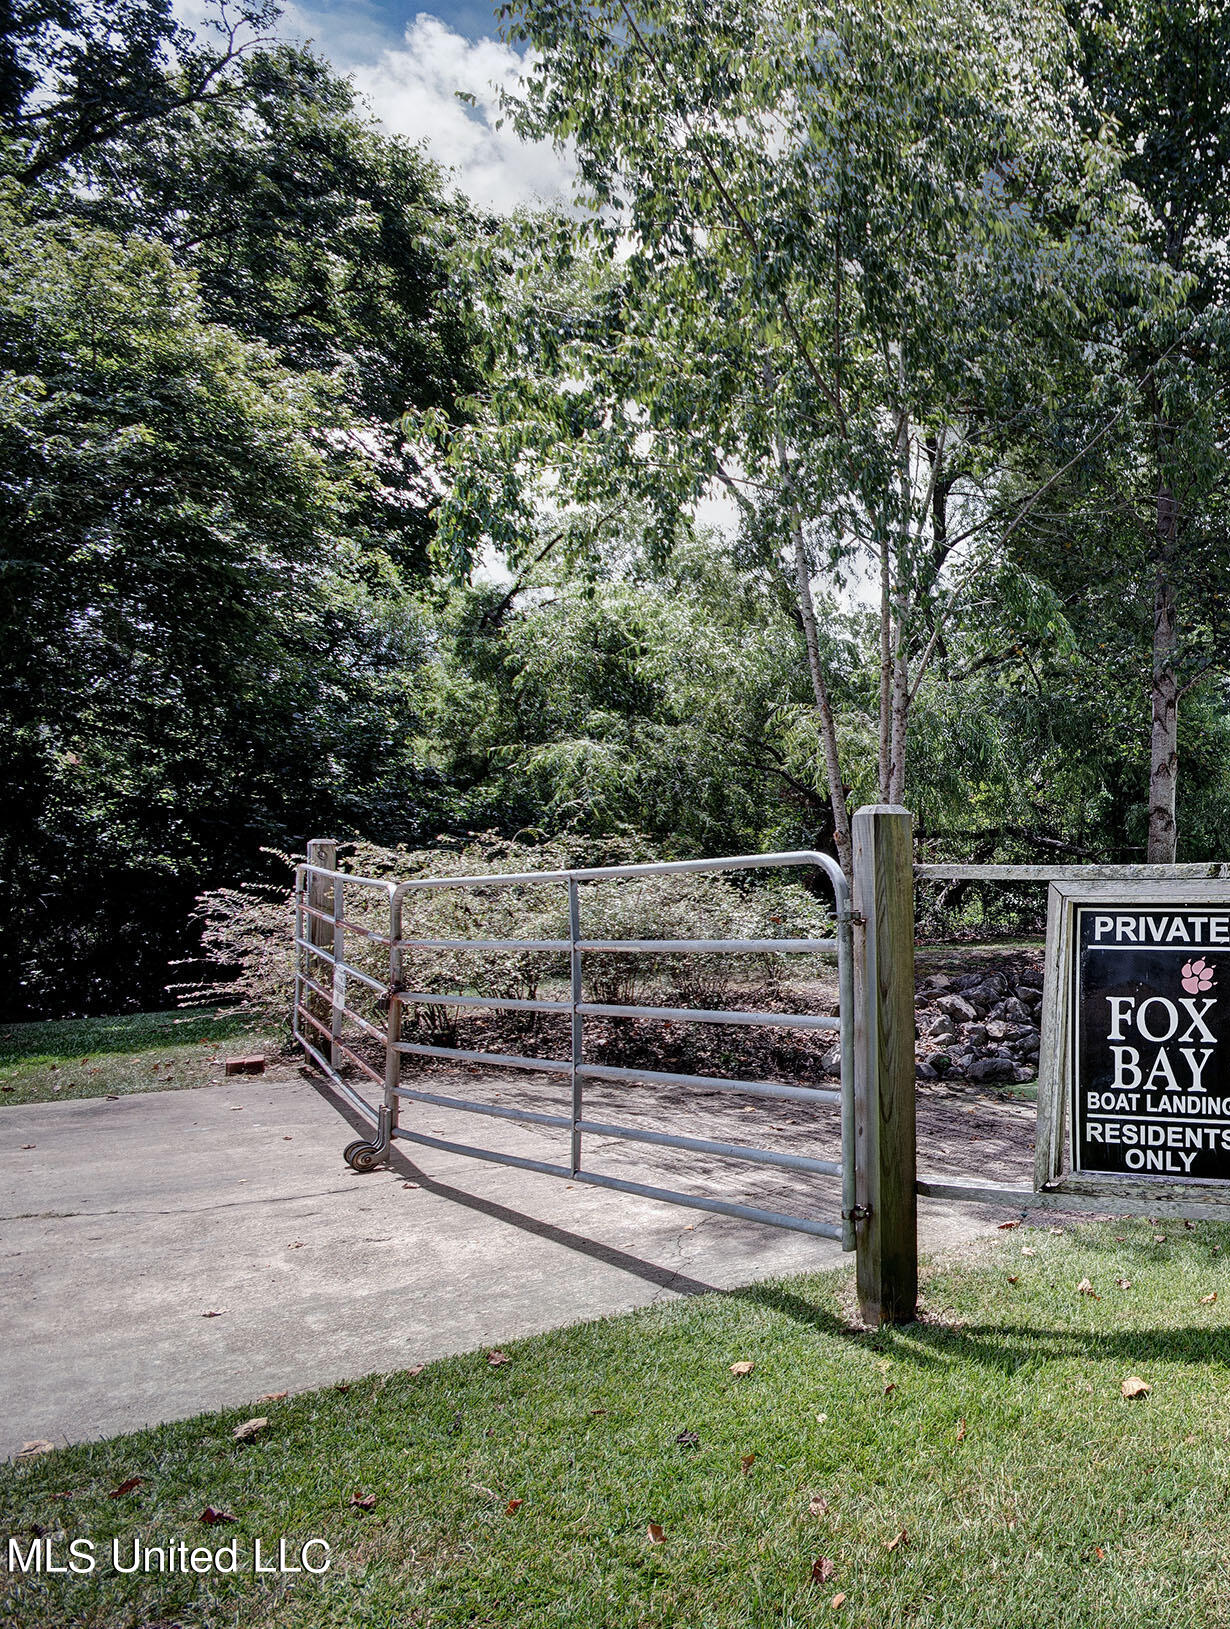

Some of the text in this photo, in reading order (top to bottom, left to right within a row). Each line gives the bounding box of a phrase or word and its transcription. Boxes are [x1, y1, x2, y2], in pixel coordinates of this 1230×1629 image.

[1094, 916, 1230, 943] PRIVATE
[1105, 996, 1218, 1043] FOX
[1108, 1045, 1214, 1093] BAY
[1087, 1091, 1141, 1111] BOAT
[1125, 1149, 1197, 1173] ONLY
